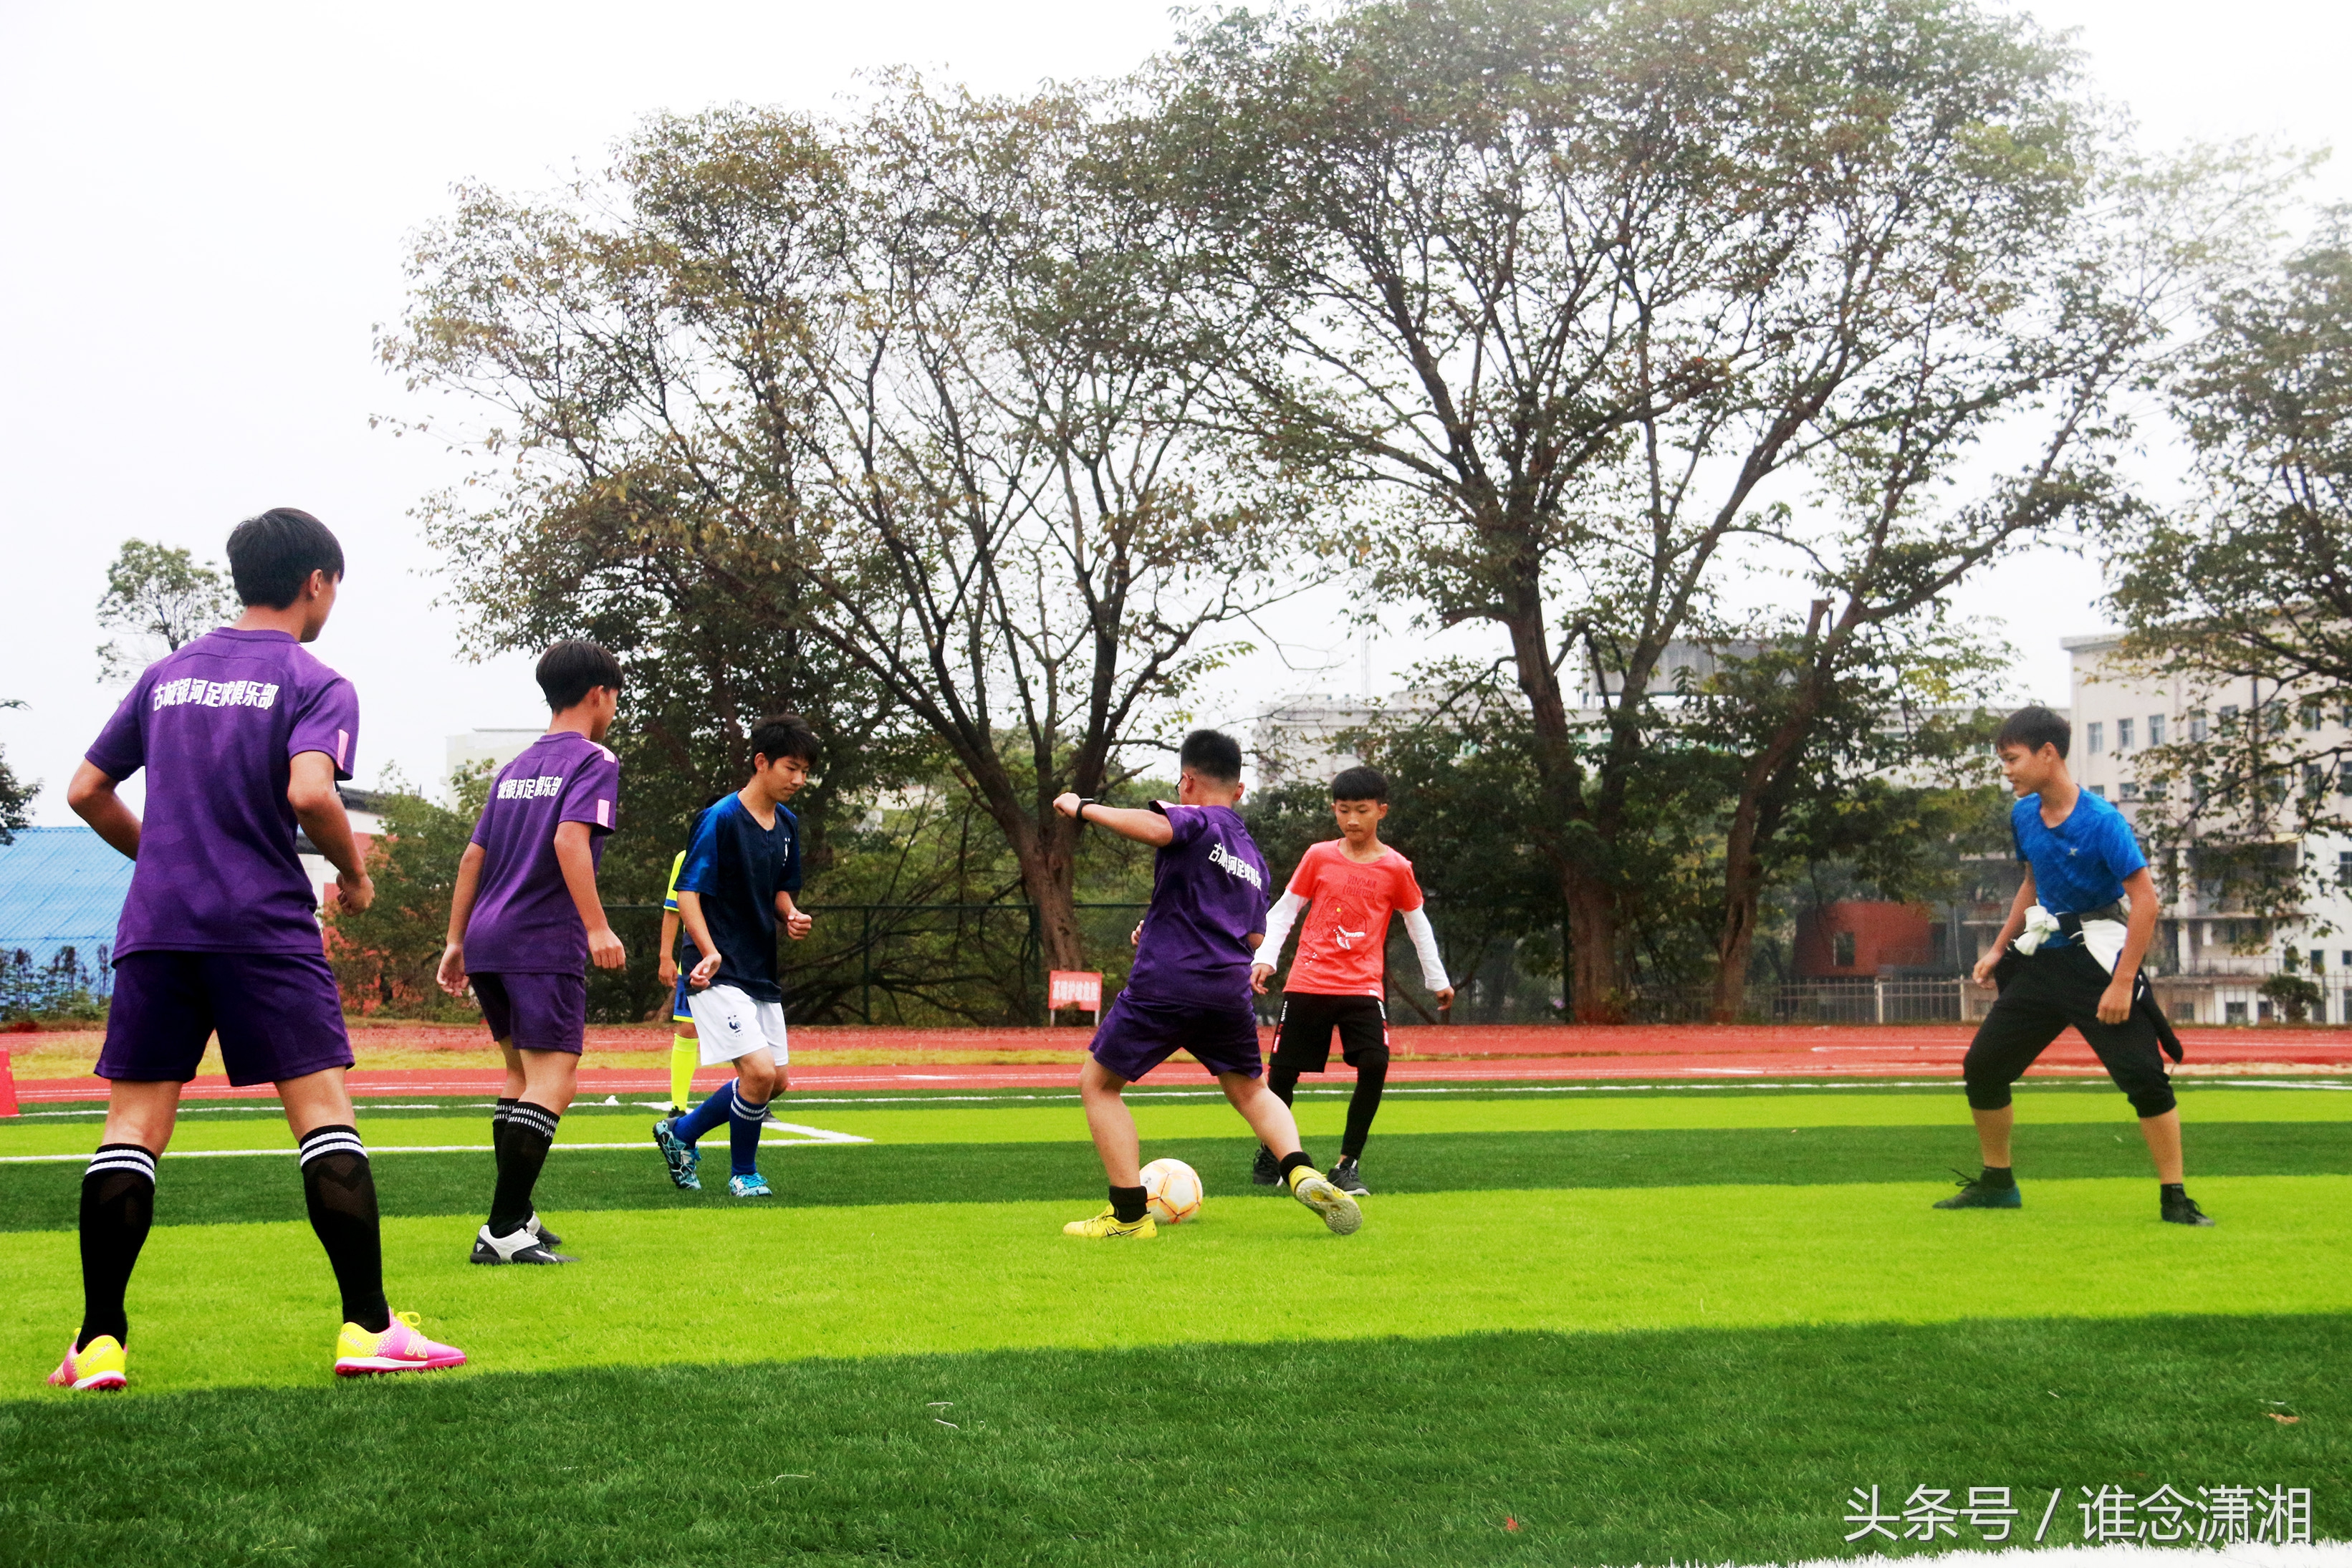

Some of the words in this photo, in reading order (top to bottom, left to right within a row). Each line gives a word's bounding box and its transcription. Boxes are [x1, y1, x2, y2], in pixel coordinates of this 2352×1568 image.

[153, 678, 279, 711] 古城银河足球俱乐部
[496, 775, 563, 799] 城银河足俱乐部
[85, 1342, 112, 1367] KELME
